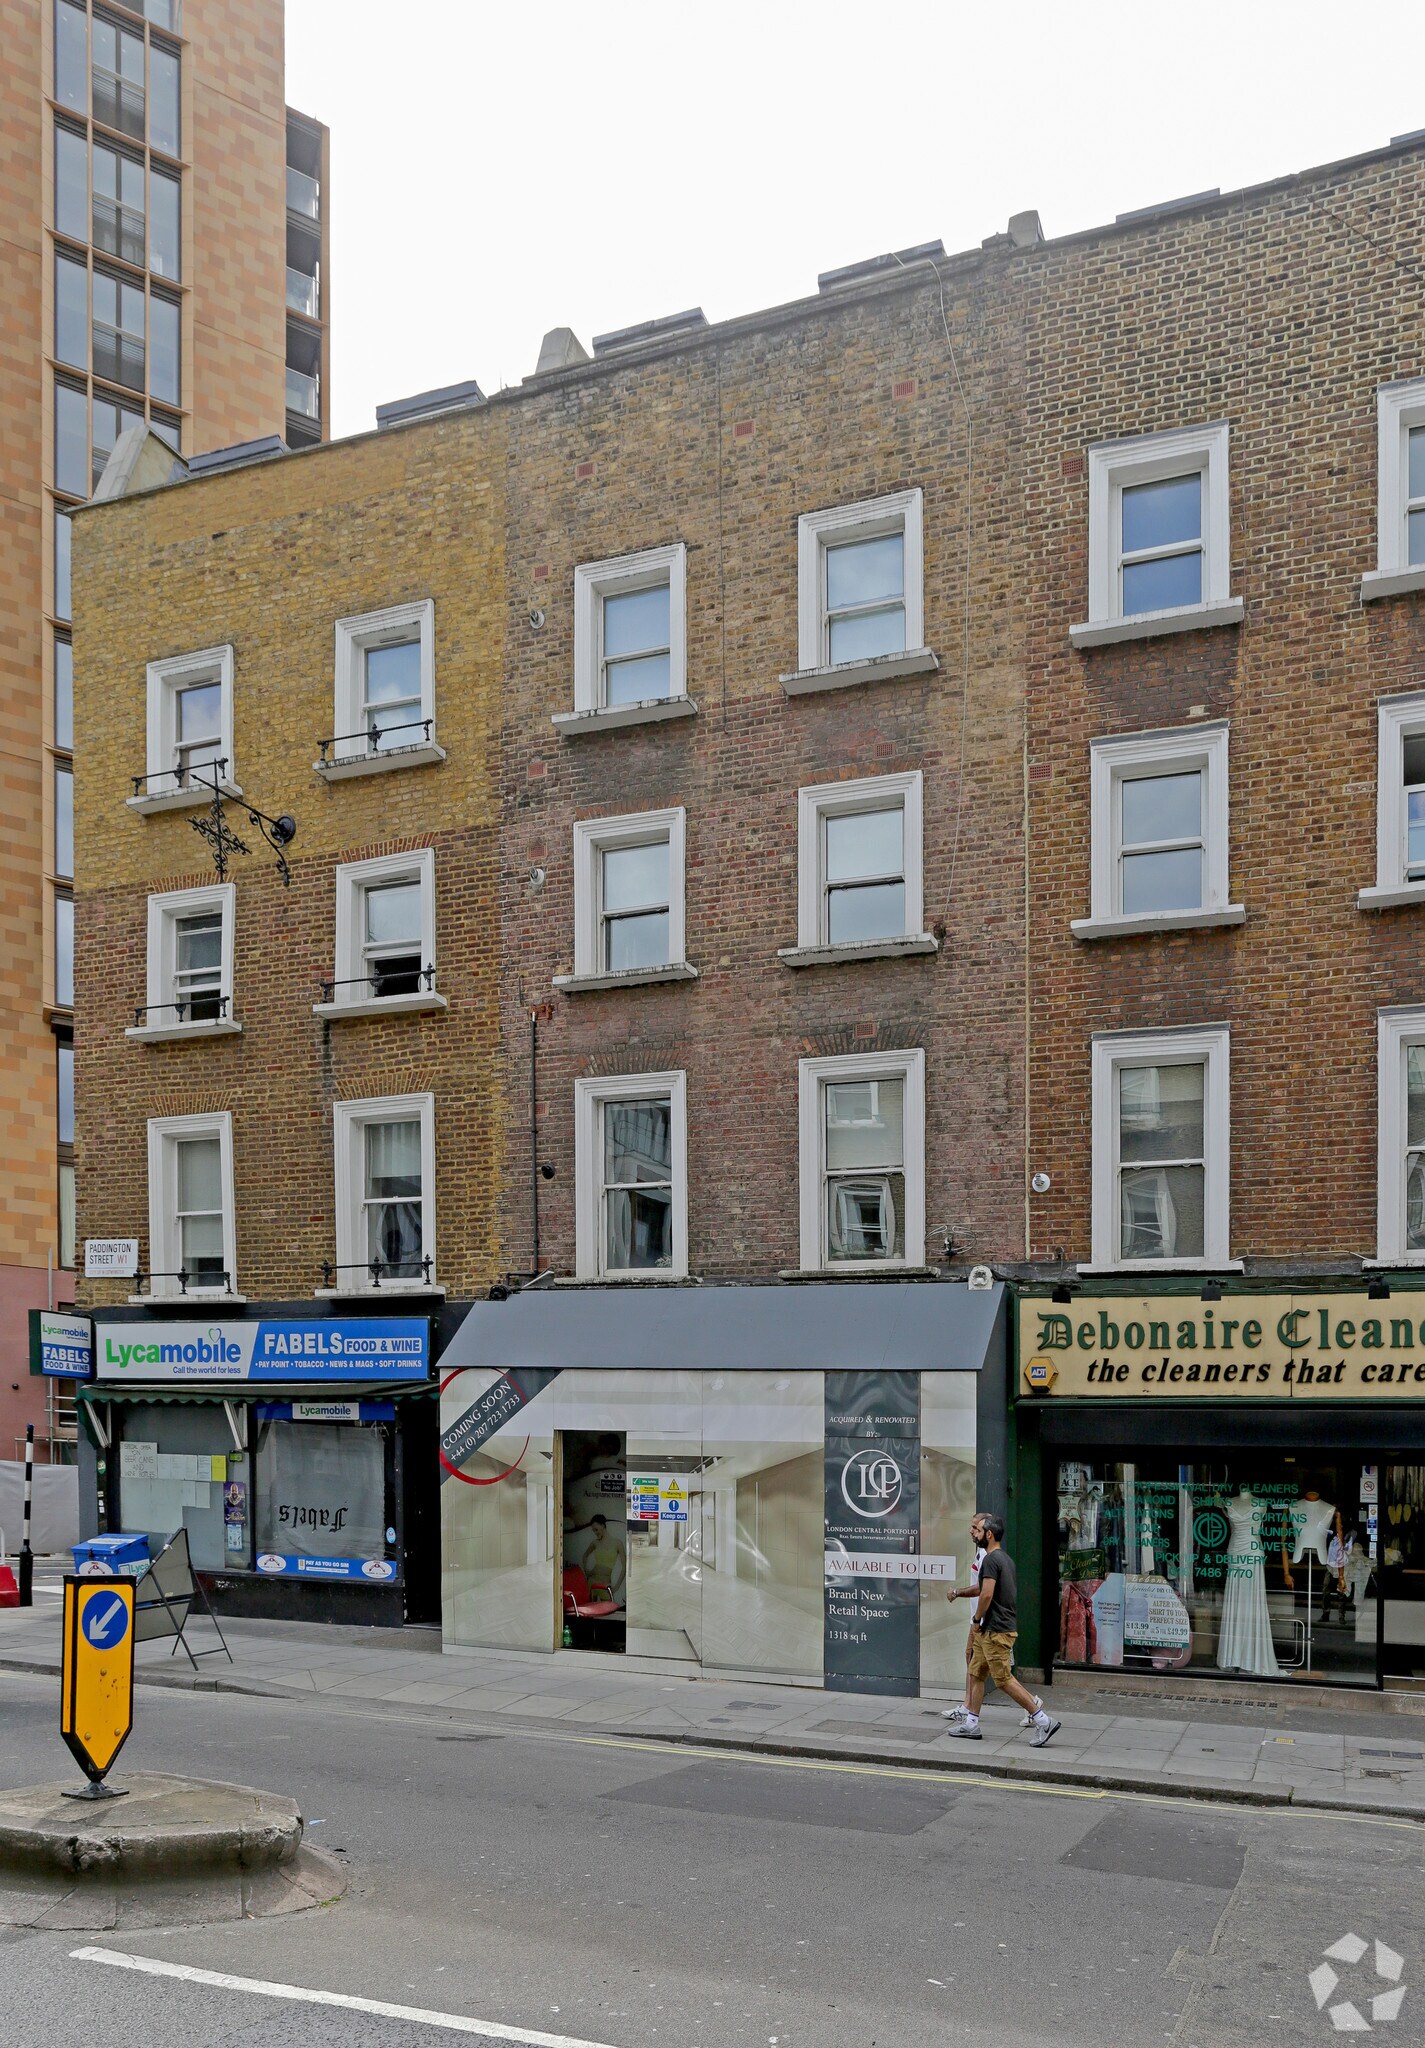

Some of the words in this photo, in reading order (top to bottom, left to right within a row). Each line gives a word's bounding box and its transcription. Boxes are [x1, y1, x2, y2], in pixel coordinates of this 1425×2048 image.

[89, 1243, 132, 1254] PADDINGTON
[89, 1254, 114, 1265] STREET
[117, 1254, 128, 1264] W1
[43, 1324, 89, 1339] Lycamobile
[1037, 1310, 1262, 1351] Debonaire
[264, 1332, 343, 1355] FABELS
[346, 1340, 377, 1352] FOOD
[380, 1340, 388, 1352] &
[391, 1339, 420, 1352] WINE
[43, 1346, 90, 1363] FABELS
[105, 1334, 241, 1368] Lycamobile
[45, 1361, 64, 1370] FOOD
[65, 1362, 70, 1370] &
[72, 1363, 89, 1372] WINE
[258, 1360, 270, 1368] PAY
[271, 1360, 289, 1368] POINT
[295, 1360, 324, 1368] TOBACCO
[329, 1360, 348, 1368] NEWS
[349, 1360, 354, 1368] &
[355, 1360, 374, 1368] MAGS
[379, 1360, 395, 1368] SOFT
[397, 1360, 422, 1368] DRINKS
[173, 1366, 186, 1374] Call
[186, 1366, 197, 1374] the
[198, 1366, 216, 1374] world
[217, 1366, 227, 1374] for
[227, 1366, 241, 1374] less
[1031, 1368, 1046, 1377] ADT
[1087, 1358, 1129, 1382] the
[1141, 1357, 1271, 1382] cleaners
[1283, 1359, 1346, 1383] that
[1361, 1362, 1425, 1383] care
[299, 1404, 351, 1416] Lycamobile
[442, 1409, 482, 1450] COMING
[481, 1381, 512, 1412] SOON
[829, 1416, 864, 1424] ACQUIRED
[865, 1415, 873, 1423] &
[450, 1445, 465, 1461] +44
[465, 1436, 476, 1450] (0)
[474, 1422, 489, 1438] 207
[487, 1410, 502, 1426] 723
[501, 1394, 520, 1414] 1733
[1061, 1479, 1079, 1487] ACE
[1239, 1483, 1299, 1494] CLEANERS
[1251, 1498, 1298, 1508] SERVICE
[1251, 1512, 1308, 1524] CURTAINS
[883, 1527, 918, 1535] PORTFOLIO
[1250, 1527, 1303, 1538] LAUNDRY
[1250, 1541, 1296, 1552] DUVETS
[1155, 1552, 1179, 1562] PICK
[1203, 1553, 1211, 1564] &
[1215, 1555, 1268, 1565] DELIVERY
[828, 1559, 893, 1573] AVAILABLE
[899, 1562, 917, 1574] TO
[923, 1563, 946, 1575] LET
[1195, 1567, 1222, 1578] 7486
[1226, 1568, 1253, 1579] 7770
[829, 1588, 858, 1600] Brand
[860, 1590, 885, 1601] New
[1153, 1600, 1170, 1608] ALTER
[829, 1604, 858, 1616] Retail
[860, 1606, 890, 1620] Space
[1149, 1608, 1166, 1616] SHIRT
[1126, 1622, 1149, 1630] £13.99
[1149, 1616, 1175, 1624] PERFECT
[1175, 1617, 1188, 1626] SIZE
[829, 1631, 848, 1639] 1318
[850, 1633, 859, 1643] sq
[860, 1632, 867, 1641] ft
[1167, 1628, 1188, 1636] £49.99
